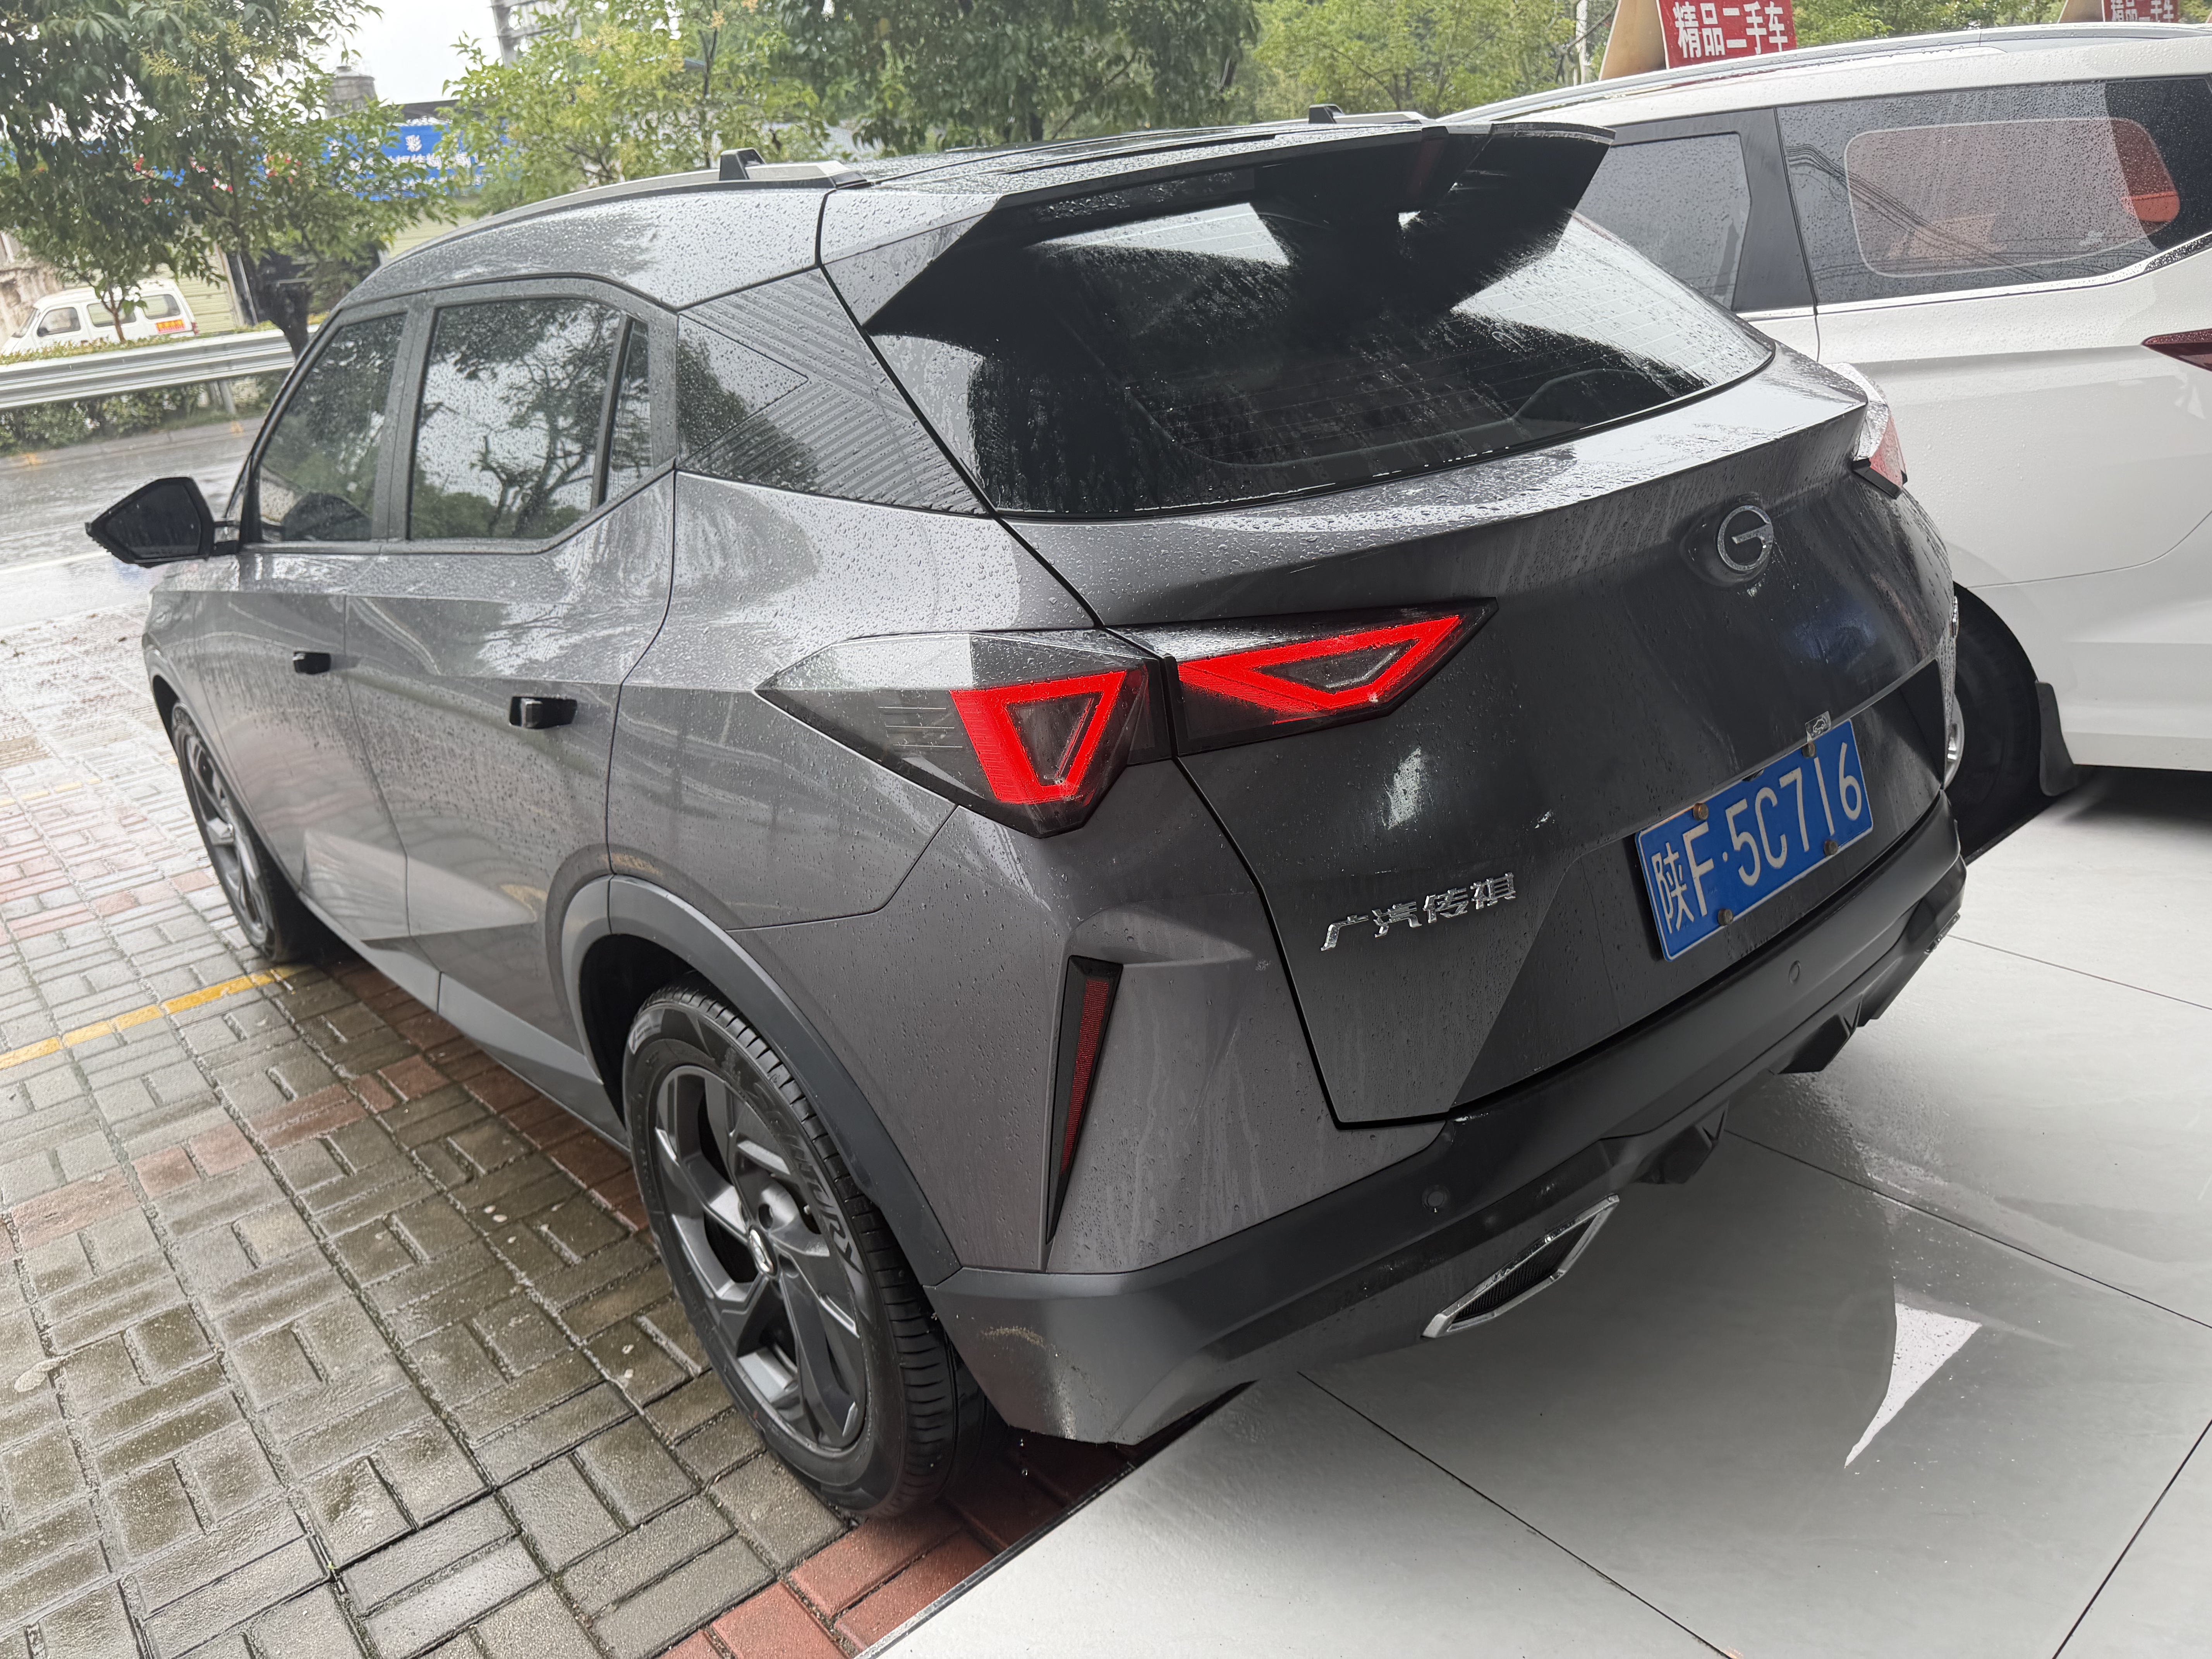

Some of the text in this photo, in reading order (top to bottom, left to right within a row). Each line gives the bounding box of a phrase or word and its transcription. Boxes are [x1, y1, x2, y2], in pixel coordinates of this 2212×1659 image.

[1673, 1, 1788, 58] 精品二手车
[1321, 872, 1516, 951] 广汽传祺
